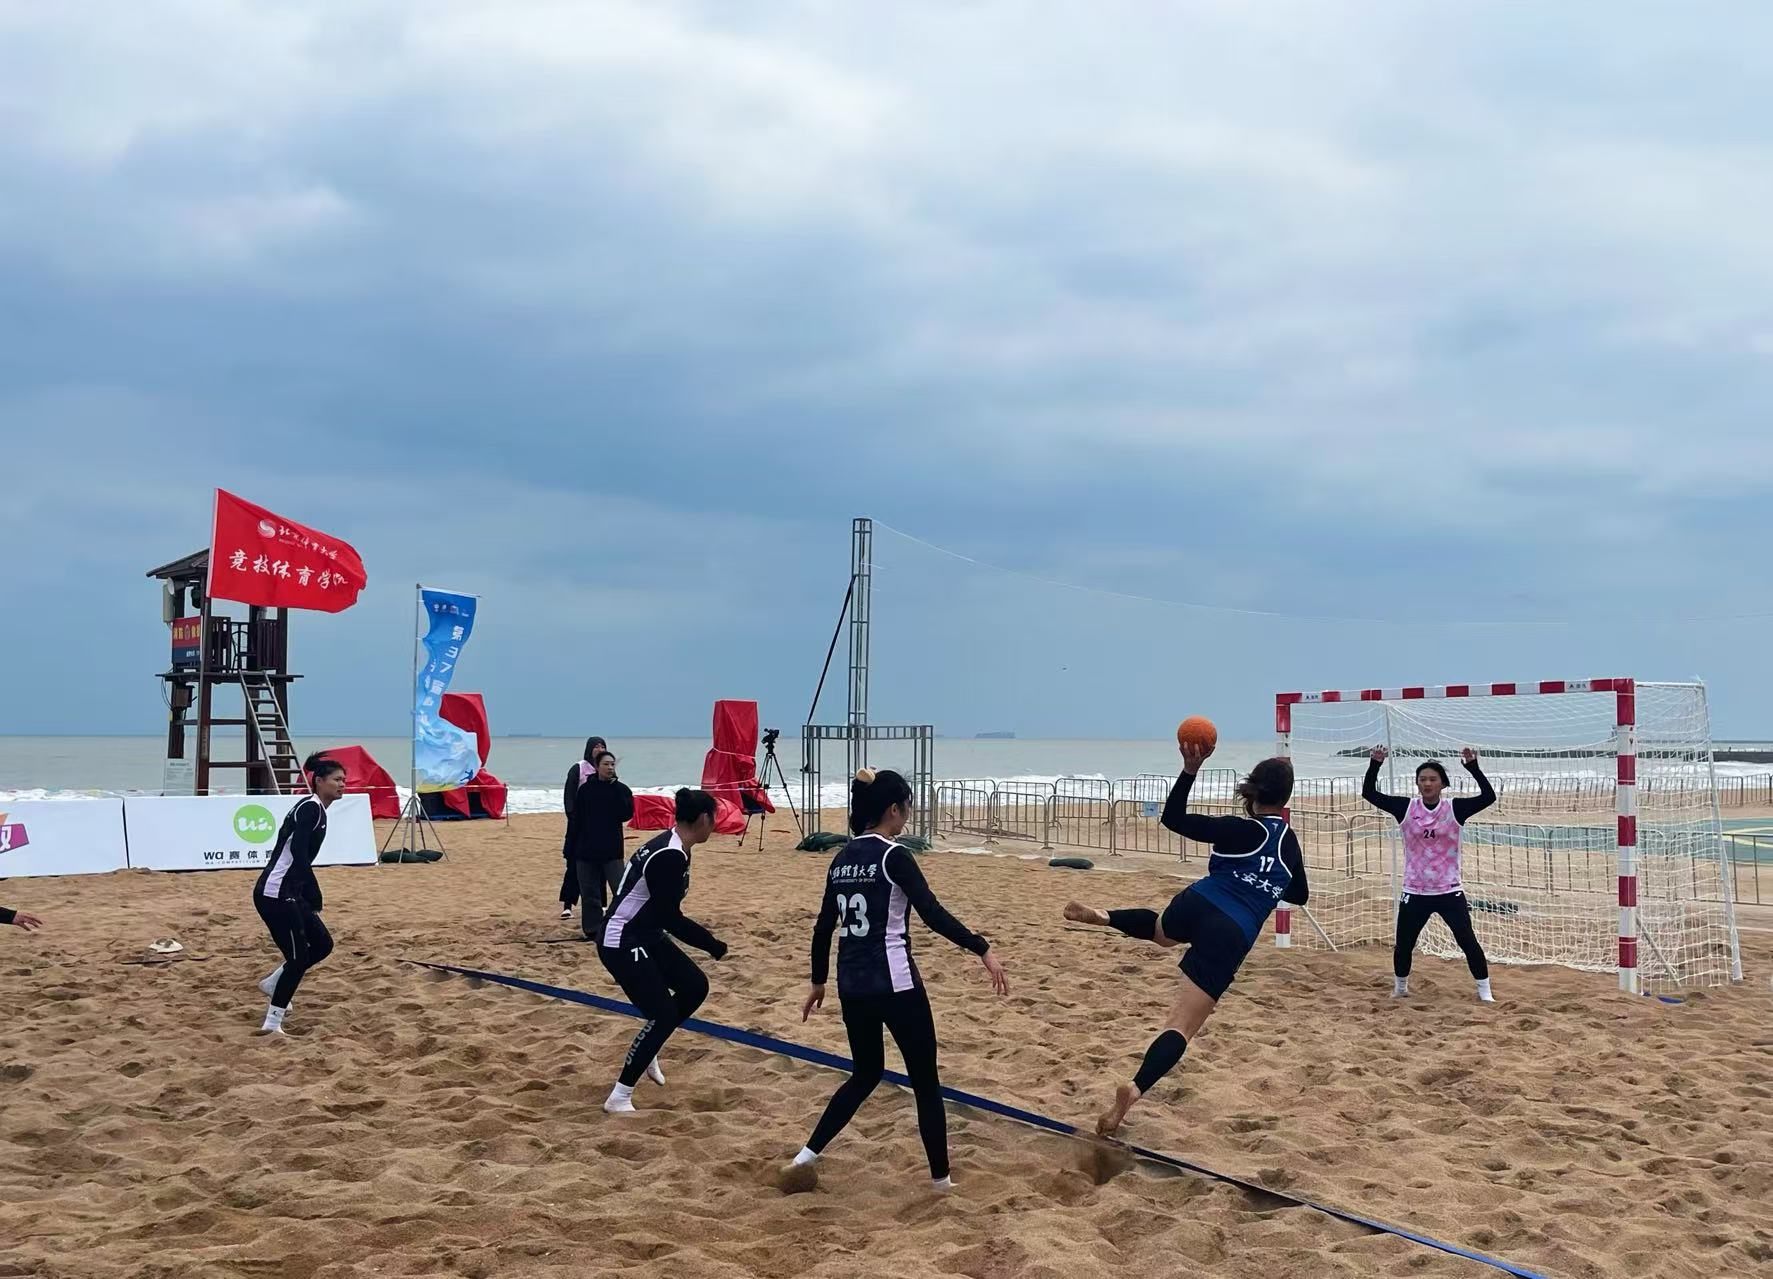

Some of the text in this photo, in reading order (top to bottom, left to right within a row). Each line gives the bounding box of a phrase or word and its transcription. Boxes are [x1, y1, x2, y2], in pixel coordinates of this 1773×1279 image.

[1423, 829, 1436, 839] 24
[1259, 856, 1275, 872] 17
[1233, 870, 1283, 898] 安大学
[836, 893, 870, 937] 23
[630, 947, 649, 962] 71
